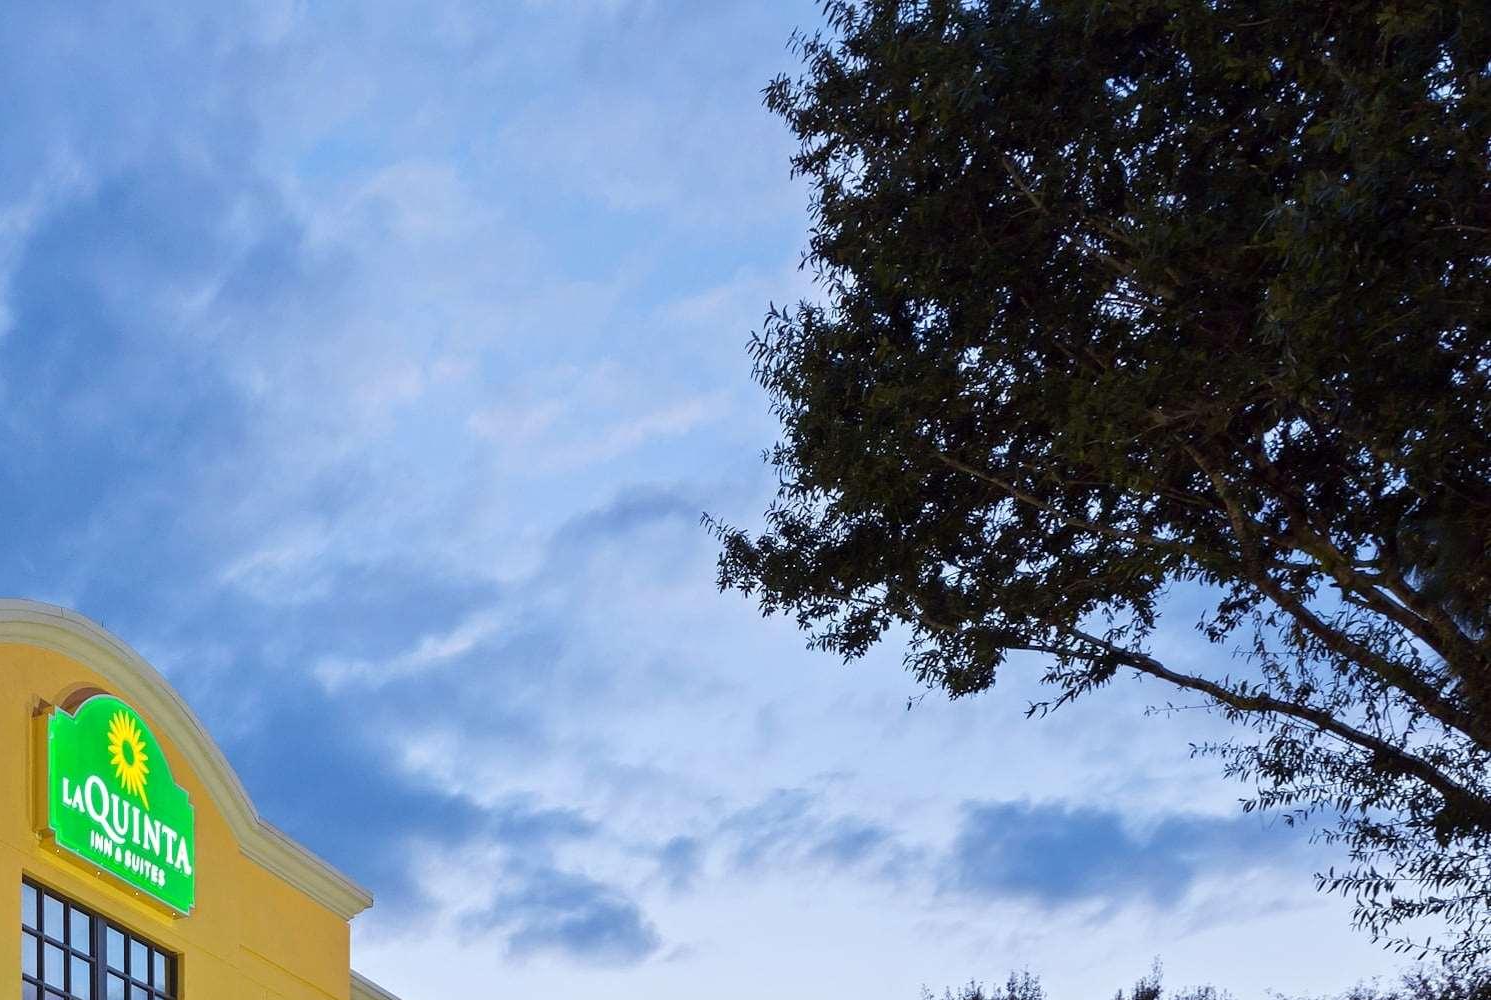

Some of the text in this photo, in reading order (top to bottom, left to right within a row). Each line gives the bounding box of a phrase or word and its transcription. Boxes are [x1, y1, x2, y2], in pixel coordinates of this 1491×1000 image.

[62, 775, 192, 876] LA QUINTA
[90, 829, 166, 887] INN & SUITES
